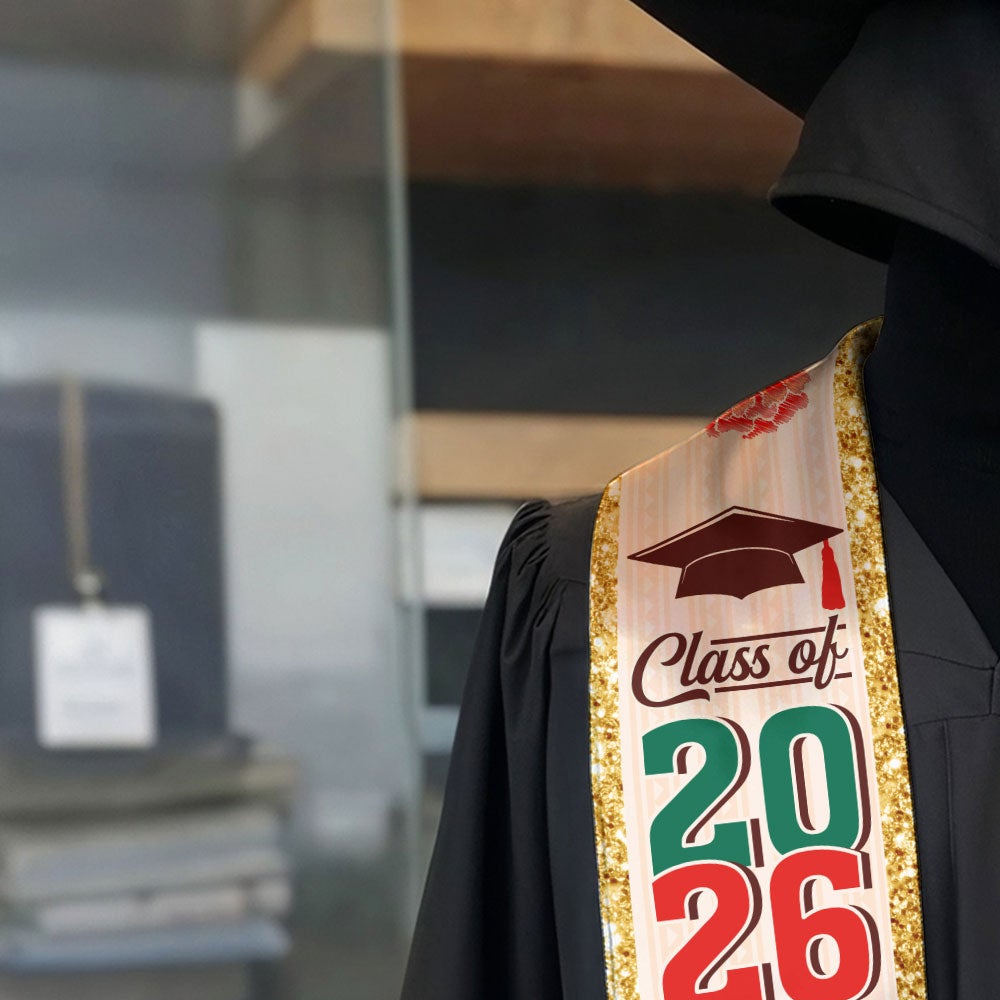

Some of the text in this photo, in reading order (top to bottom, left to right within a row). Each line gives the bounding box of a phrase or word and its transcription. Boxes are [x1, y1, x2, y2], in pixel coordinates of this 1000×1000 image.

[631, 614, 849, 708] Class of
[642, 703, 871, 876] 20
